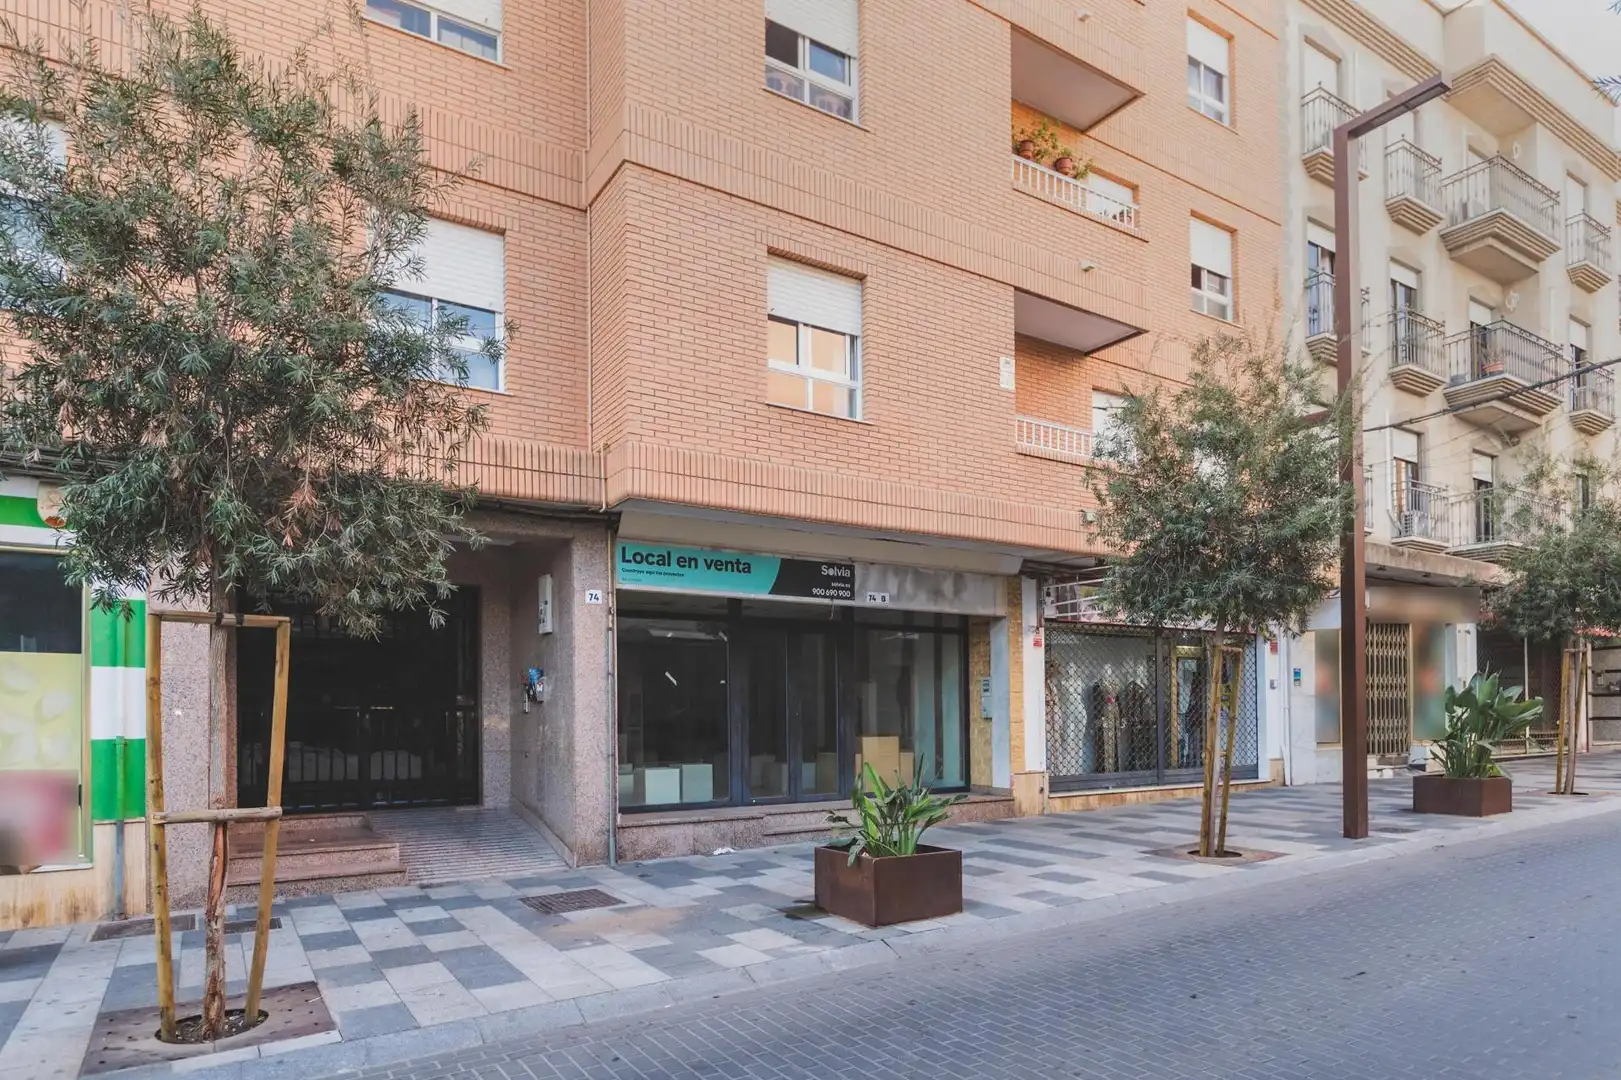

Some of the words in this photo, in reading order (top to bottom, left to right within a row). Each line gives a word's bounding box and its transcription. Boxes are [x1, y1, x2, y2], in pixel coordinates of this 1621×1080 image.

[621, 546, 671, 568] Local
[676, 555, 699, 569] en
[704, 558, 752, 574] venta
[821, 565, 851, 577] Solvia
[588, 593, 599, 601] 74
[812, 587, 825, 595] 900
[825, 589, 838, 597] 690
[838, 590, 851, 598] 900
[868, 594, 876, 602] 74
